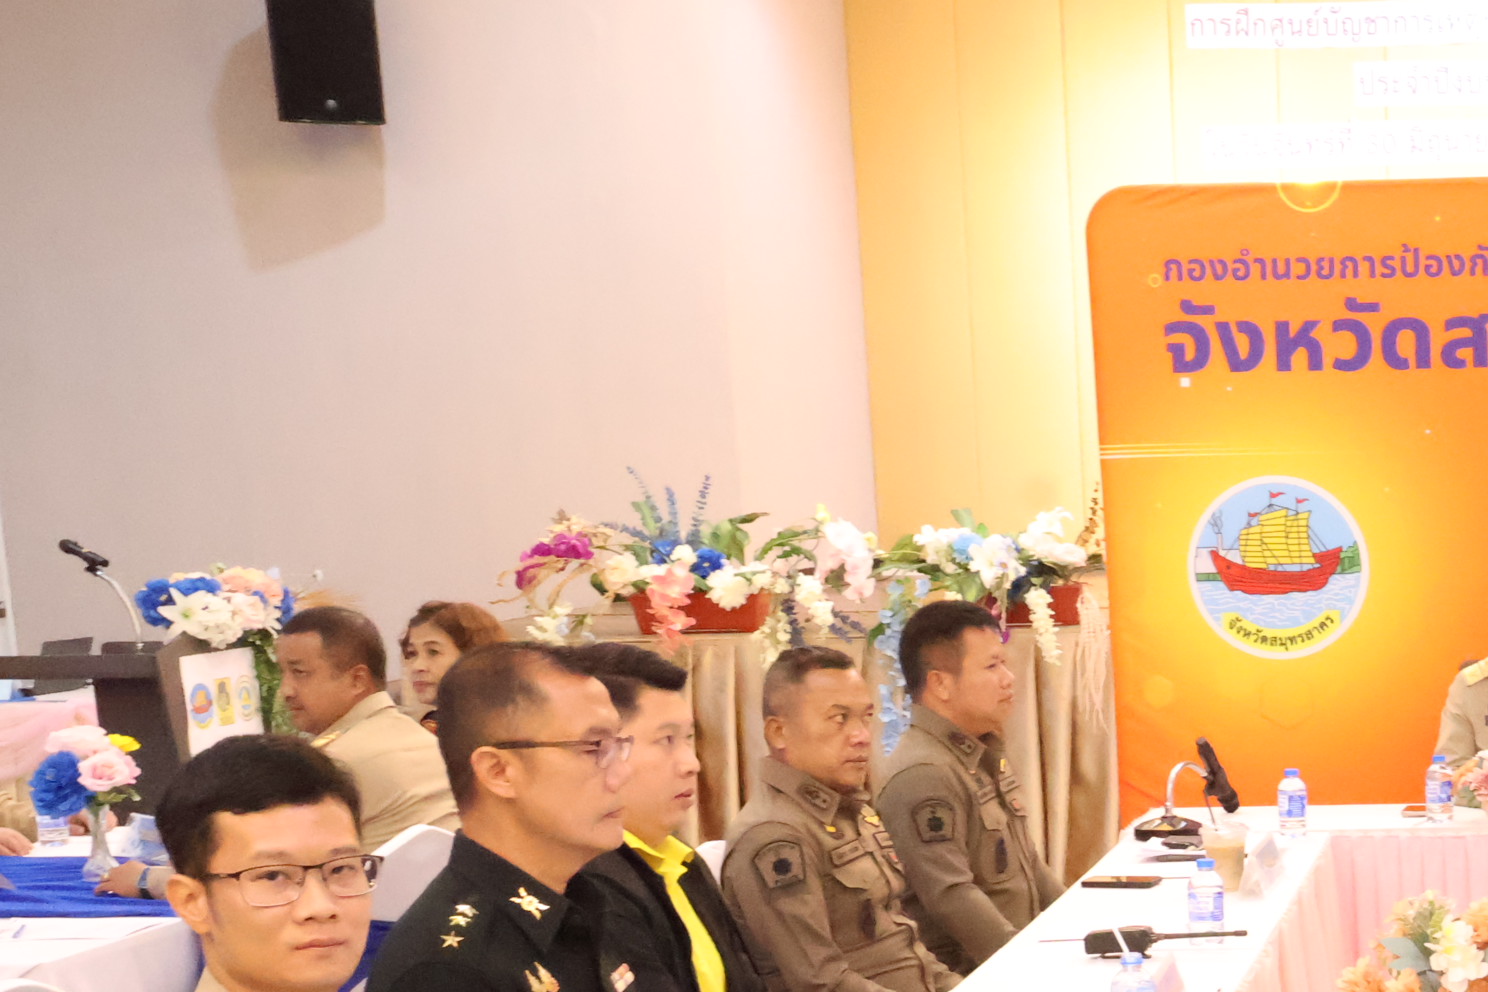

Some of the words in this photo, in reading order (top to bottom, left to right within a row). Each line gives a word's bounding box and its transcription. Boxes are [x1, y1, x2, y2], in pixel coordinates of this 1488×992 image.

[1227, 614, 1336, 652] จังหวัดสมุทรสาคร
